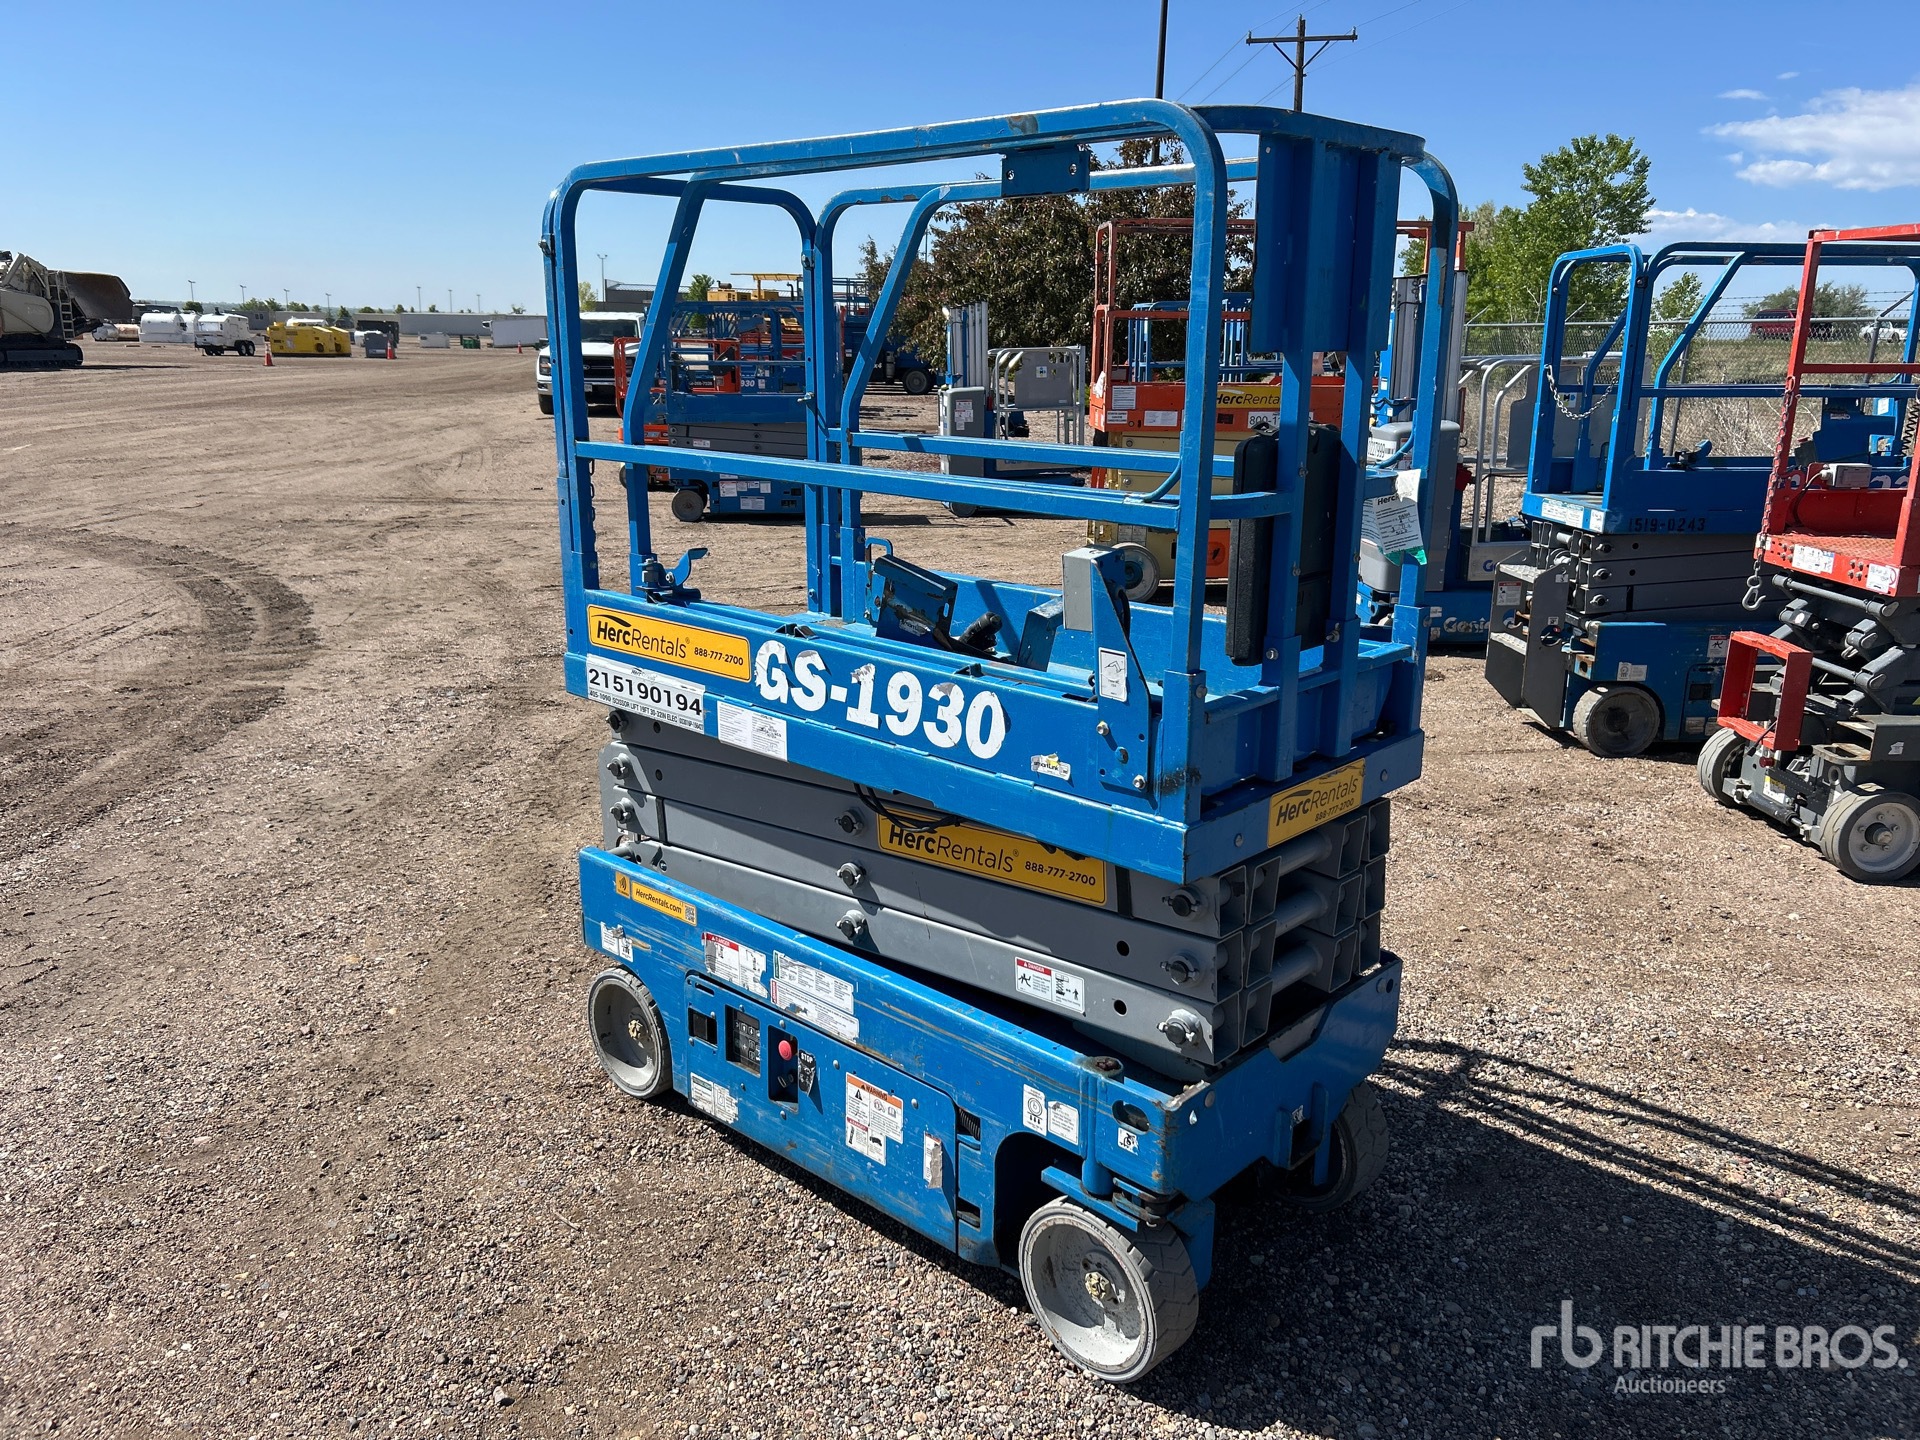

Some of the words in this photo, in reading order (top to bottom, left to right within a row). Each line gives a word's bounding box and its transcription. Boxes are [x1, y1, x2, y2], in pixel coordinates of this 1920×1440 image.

[1628, 517, 1706, 533] 1519-0243
[694, 646, 744, 666] 888-777-2700
[588, 668, 702, 716] 215190194
[754, 639, 1006, 760] GS-1930
[630, 702, 640, 711] LIFT
[667, 713, 678, 723] ELEC
[1315, 797, 1355, 822] 888-777-2700
[1025, 860, 1096, 886] 888-777-2700
[635, 888, 682, 914] HercRentals.com
[1028, 962, 1045, 973] DANGER
[800, 1053, 813, 1064] STOP
